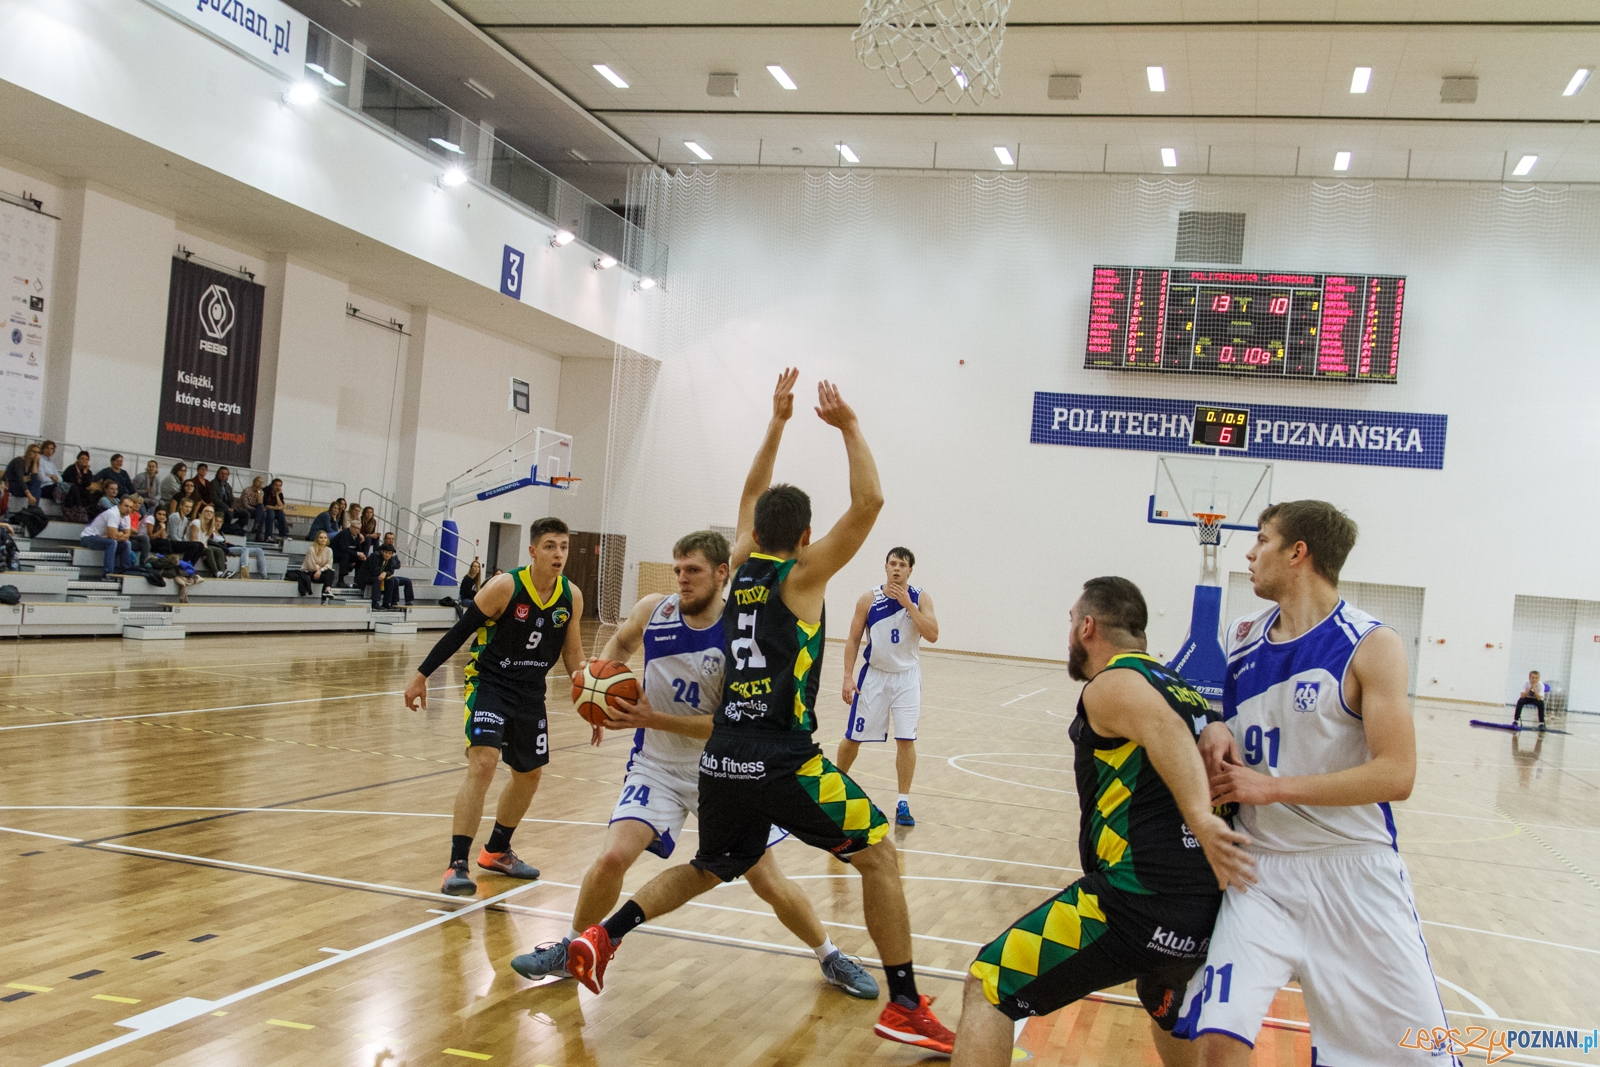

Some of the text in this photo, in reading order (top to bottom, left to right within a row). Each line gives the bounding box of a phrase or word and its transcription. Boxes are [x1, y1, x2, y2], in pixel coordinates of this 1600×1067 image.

[507, 252, 521, 293] 3
[1212, 295, 1231, 312] 13
[1242, 304, 1247, 312] 1
[1269, 298, 1289, 314] 10
[1311, 302, 1319, 311] 3
[1185, 321, 1193, 332] 2
[1309, 327, 1317, 336] 4
[199, 339, 228, 356] REBIS
[1195, 344, 1202, 354] 5
[1277, 349, 1284, 358] 5
[177, 370, 214, 392] Książki,
[175, 390, 241, 416] które się czyta
[165, 421, 246, 445] www.rebis.com.pl
[1051, 407, 1424, 452] POLITECHN POZNAŃSKA
[1219, 427, 1233, 443] 6
[485, 481, 520, 497] PESMENPOL
[525, 630, 543, 650] 9
[890, 628, 900, 644] 8
[1175, 642, 1197, 674] HYDROPLAY
[672, 678, 701, 708] 24
[855, 717, 865, 733] 8
[535, 732, 549, 756] 9
[1244, 724, 1280, 768] 91
[721, 757, 765, 773] fitness
[619, 784, 651, 807] 24
[1152, 926, 1196, 952] klub
